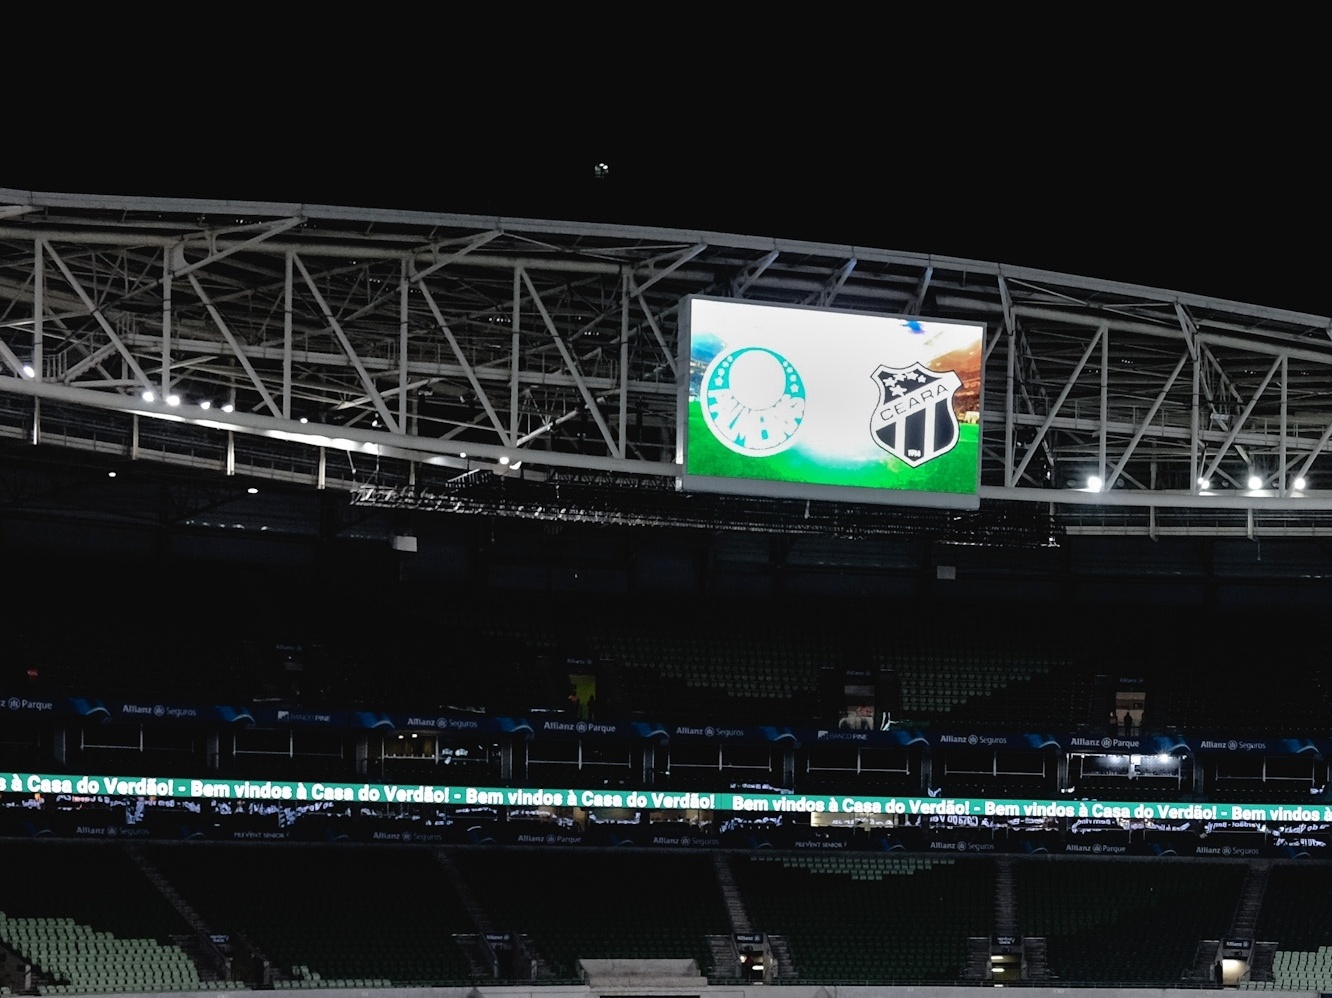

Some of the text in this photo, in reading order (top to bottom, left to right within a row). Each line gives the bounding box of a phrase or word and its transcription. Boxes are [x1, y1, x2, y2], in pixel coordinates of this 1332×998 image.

[21, 700, 52, 710] Parque
[123, 705, 152, 714] Allianz
[407, 718, 436, 727] Allianz
[543, 722, 616, 734] Allianz Parque
[676, 727, 703, 735] Allianz
[940, 735, 967, 743] Allianz
[1071, 738, 1140, 749] Allianz Parque
[1201, 741, 1228, 749] Allianz
[11, 774, 23, 790] à
[26, 775, 73, 793] Casa
[76, 777, 100, 794] do
[103, 778, 174, 796] Verdão!
[190, 781, 231, 797] Bem
[233, 782, 293, 799] vindos
[296, 784, 308, 799] à
[311, 784, 354, 800] Casa
[357, 786, 381, 801] do
[383, 786, 450, 803] Verdão!
[465, 788, 504, 804] Bem
[507, 790, 564, 806] vindos
[567, 791, 578, 806] à
[581, 791, 623, 806] Casa
[626, 792, 648, 807] do
[650, 793, 716, 809] Verdão!
[732, 796, 769, 811] Bem
[771, 797, 825, 812] vindos
[828, 797, 839, 812] à
[841, 798, 882, 813] Casa
[885, 799, 906, 814] do
[908, 800, 970, 815] Verdão!
[984, 801, 1020, 816] Bem
[1023, 802, 1075, 817] vindos
[1078, 803, 1089, 817] à
[1091, 804, 1130, 818] Casa
[1134, 804, 1154, 818] do
[1156, 805, 1217, 819] Verdão!
[1231, 806, 1266, 820] Bem
[1269, 807, 1321, 821] vindos
